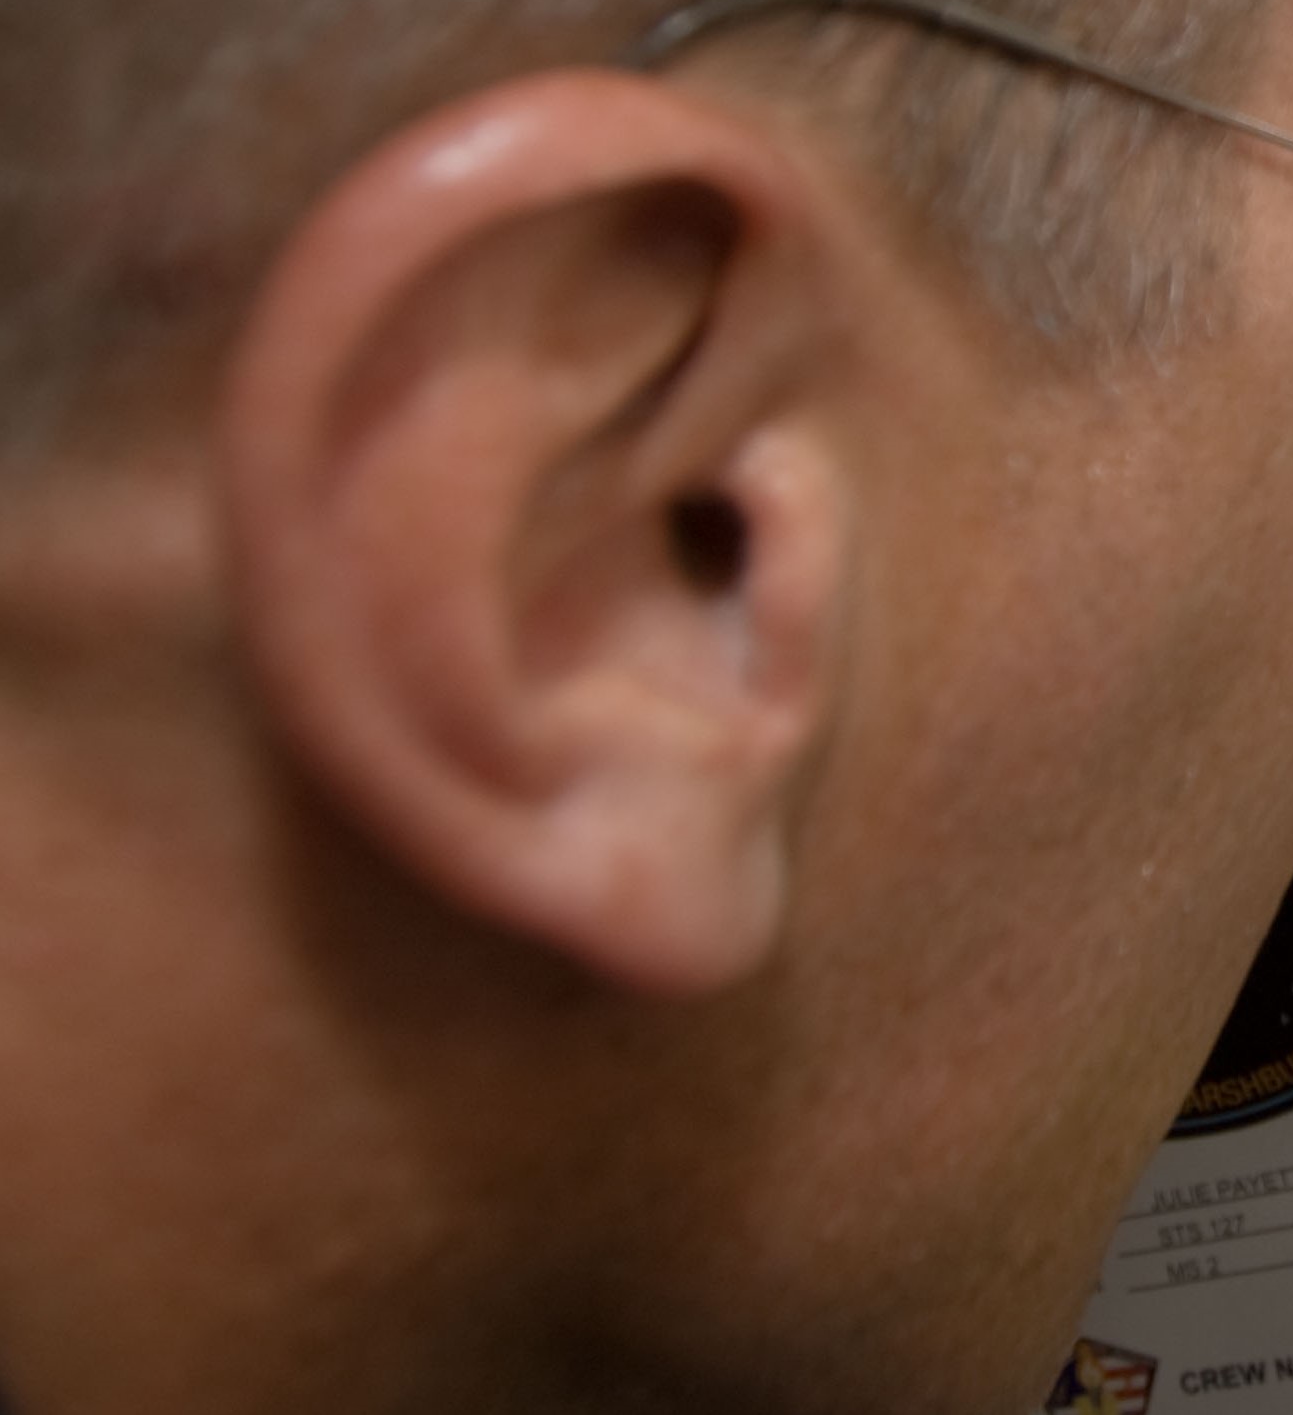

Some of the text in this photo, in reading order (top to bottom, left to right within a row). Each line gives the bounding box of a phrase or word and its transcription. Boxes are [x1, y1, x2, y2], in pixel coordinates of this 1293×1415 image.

[1150, 1176, 1213, 1214] JULIE
[1157, 1214, 1247, 1249] STS 127
[1166, 1259, 1202, 1284] MS
[1179, 1360, 1268, 1396] CREW
